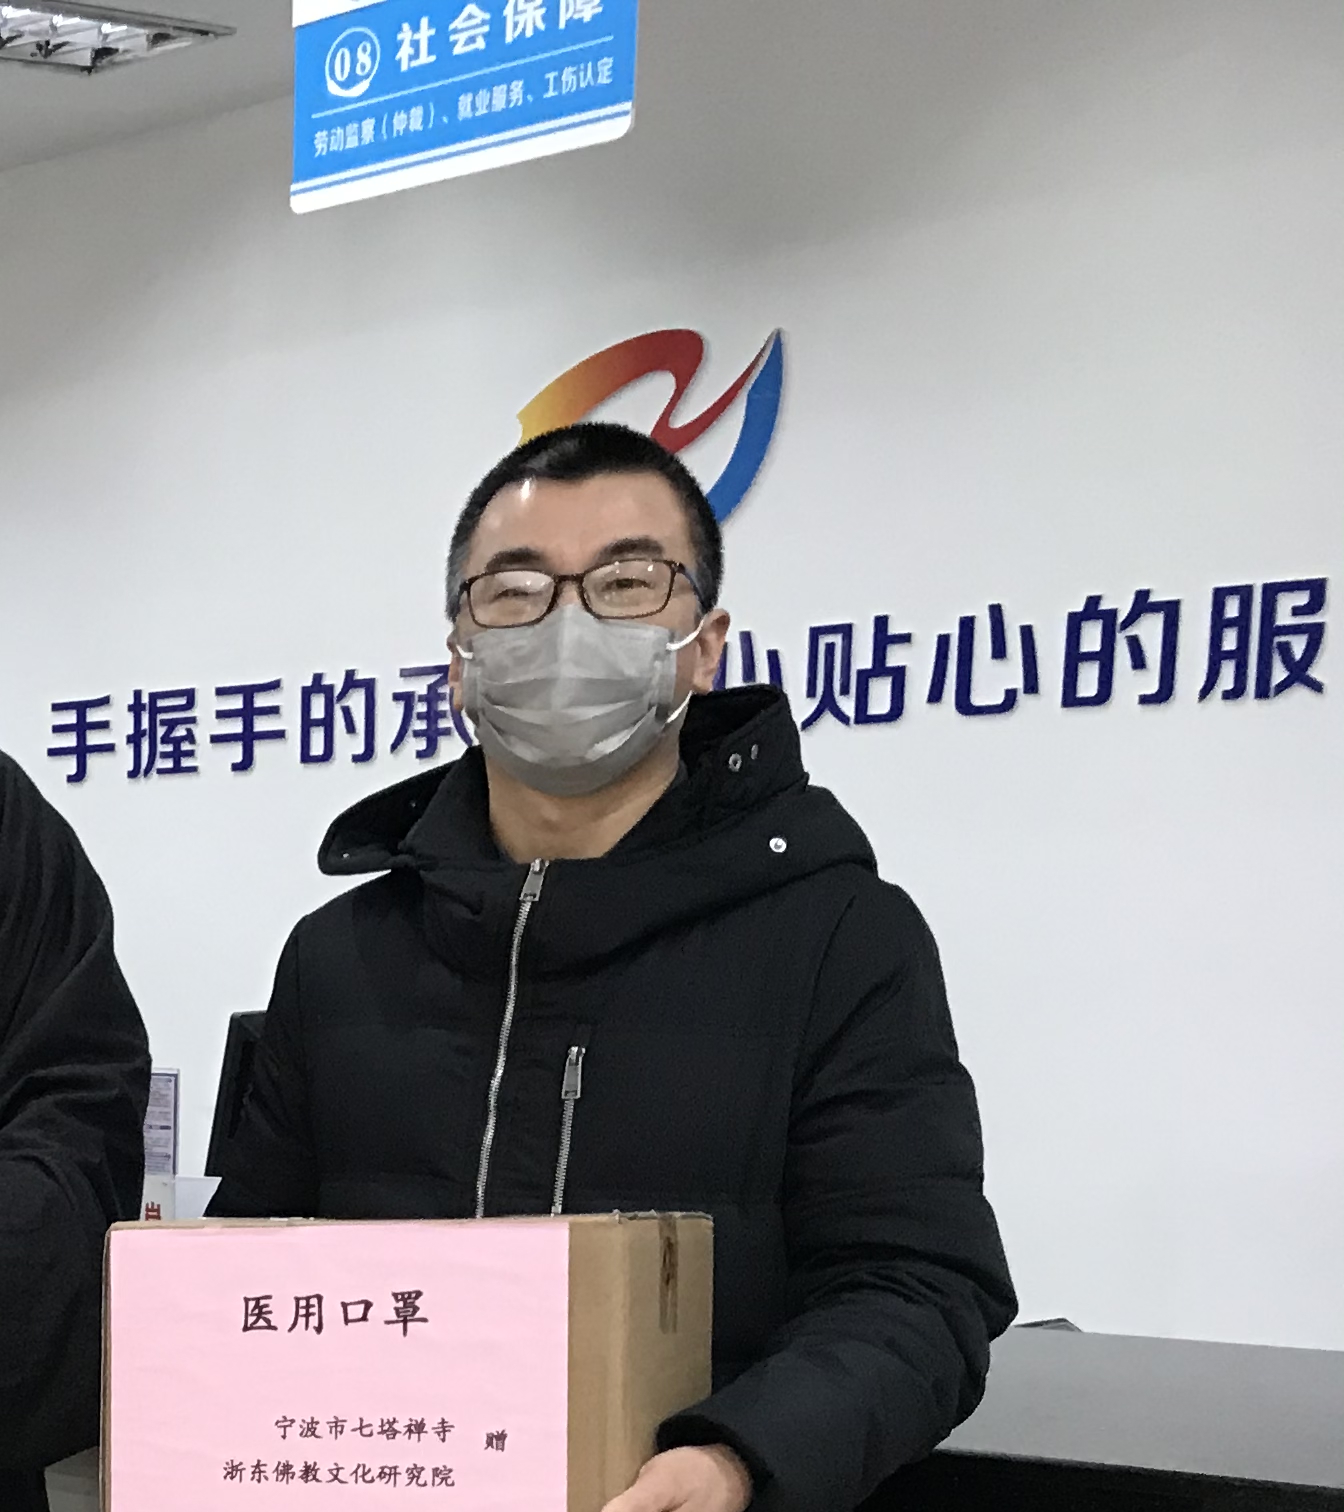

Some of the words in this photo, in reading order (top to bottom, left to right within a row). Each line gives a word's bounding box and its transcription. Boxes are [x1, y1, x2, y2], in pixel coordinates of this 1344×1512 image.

[334, 41, 373, 83] 08
[395, 0, 604, 73] 社会保障
[242, 1290, 429, 1337] 医用口罩
[274, 1415, 455, 1443] 宁波市七塔禅寺
[484, 1429, 508, 1452] 赠
[223, 1459, 456, 1488] 浙东佛教文化研究院
